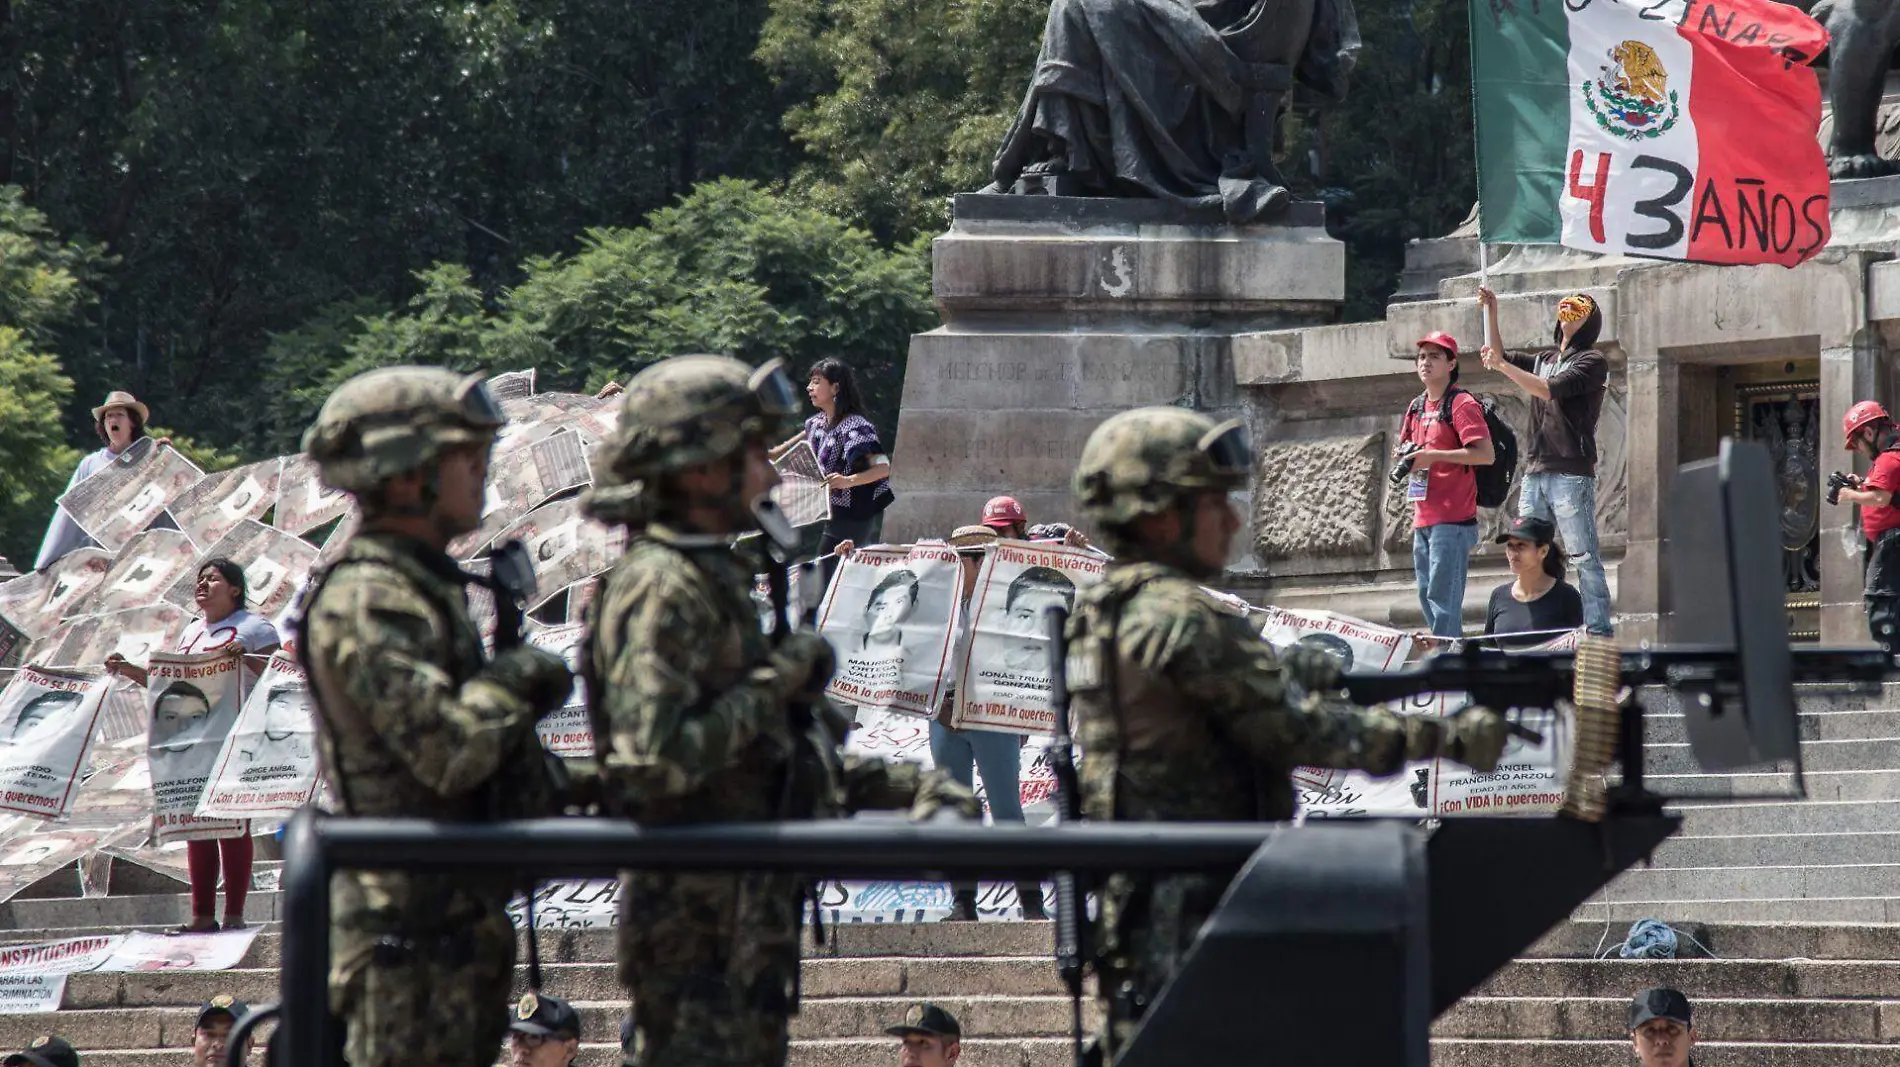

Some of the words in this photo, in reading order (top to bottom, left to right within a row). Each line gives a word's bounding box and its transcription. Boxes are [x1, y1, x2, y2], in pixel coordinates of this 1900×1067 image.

[1570, 148, 1694, 248] 43
[1692, 178, 1828, 255] AÑOS
[1026, 553, 1037, 566] se
[1039, 553, 1050, 567] lo
[1309, 619, 1321, 630] se
[161, 667, 171, 677] se
[173, 666, 182, 677] lo
[184, 658, 237, 679] llevaron!
[50, 680, 63, 690] se
[832, 680, 858, 695] VIDA
[861, 687, 871, 698] lo
[874, 688, 929, 705] queremos!
[992, 691, 1013, 699] EDAD
[966, 701, 983, 716] ¡Con
[986, 703, 1006, 716] VIDA
[1008, 705, 1017, 717] lo
[551, 731, 561, 744] lo
[1449, 773, 1510, 787] FRANCISCO
[1470, 786, 1494, 794] EDAD
[5, 790, 59, 808] queremos!
[1440, 799, 1462, 813] ¡Con
[1465, 795, 1490, 809] VIDA
[1494, 793, 1503, 806] lo
[1507, 791, 1565, 807] queremos!
[168, 812, 177, 825] lo
